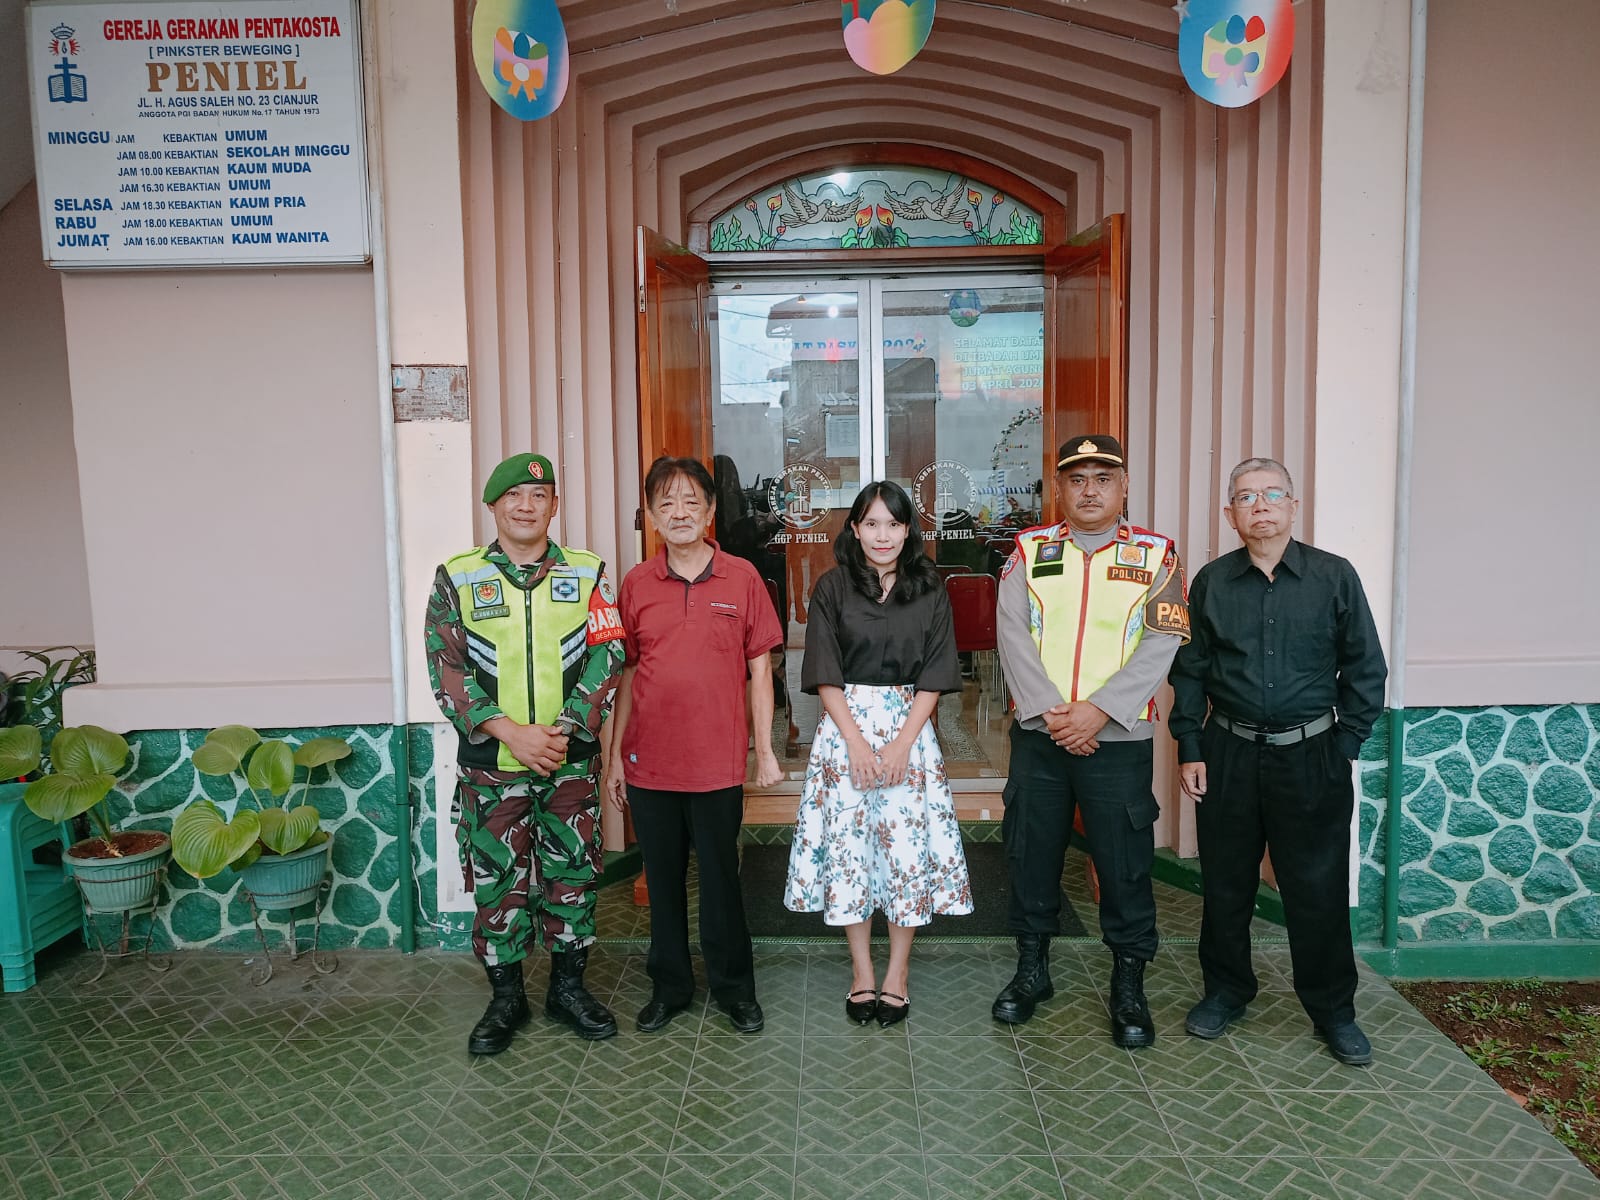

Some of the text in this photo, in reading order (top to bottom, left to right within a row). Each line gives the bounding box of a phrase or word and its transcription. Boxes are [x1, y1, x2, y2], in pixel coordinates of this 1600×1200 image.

[103, 16, 341, 40] GEREJA GERAKAN PENTAKOSTA
[157, 45, 220, 57] PINKSTER
[223, 44, 292, 56] BEWEGING
[145, 60, 307, 92] PENIEL
[137, 94, 318, 108] JL. H. AGUS SALEH NO. 23 CIANJUR
[138, 110, 176, 118] ANGGOTA
[193, 110, 220, 118] BADAN
[222, 109, 250, 117] HUKUM
[48, 129, 268, 145] MINGGU JAM KEBAKTIAN UMUM
[116, 144, 350, 160] JAM 08.00 KEBAKTIAN SEKOLAH MINGGU
[117, 161, 312, 177] JAM 10.00 KEBAKTIAN KAUM MUDA
[119, 179, 271, 193] JAM 16.30 KEBAKTIAN UMUM
[54, 196, 306, 211] SELASA JAM 18.30 KEBAKTIAN KAUM PRIA
[55, 215, 273, 230] RABU JAM 18.00 KEBAKTIAN UMUM
[57, 231, 329, 247] JUMAT JAM 16.00 KEBAKTIAN KAUM WANITA
[954, 337, 1008, 348] SELAMAT
[774, 533, 829, 544] GGP PENIEL
[941, 529, 975, 540] PENIEL
[1111, 568, 1148, 583] POLISI
